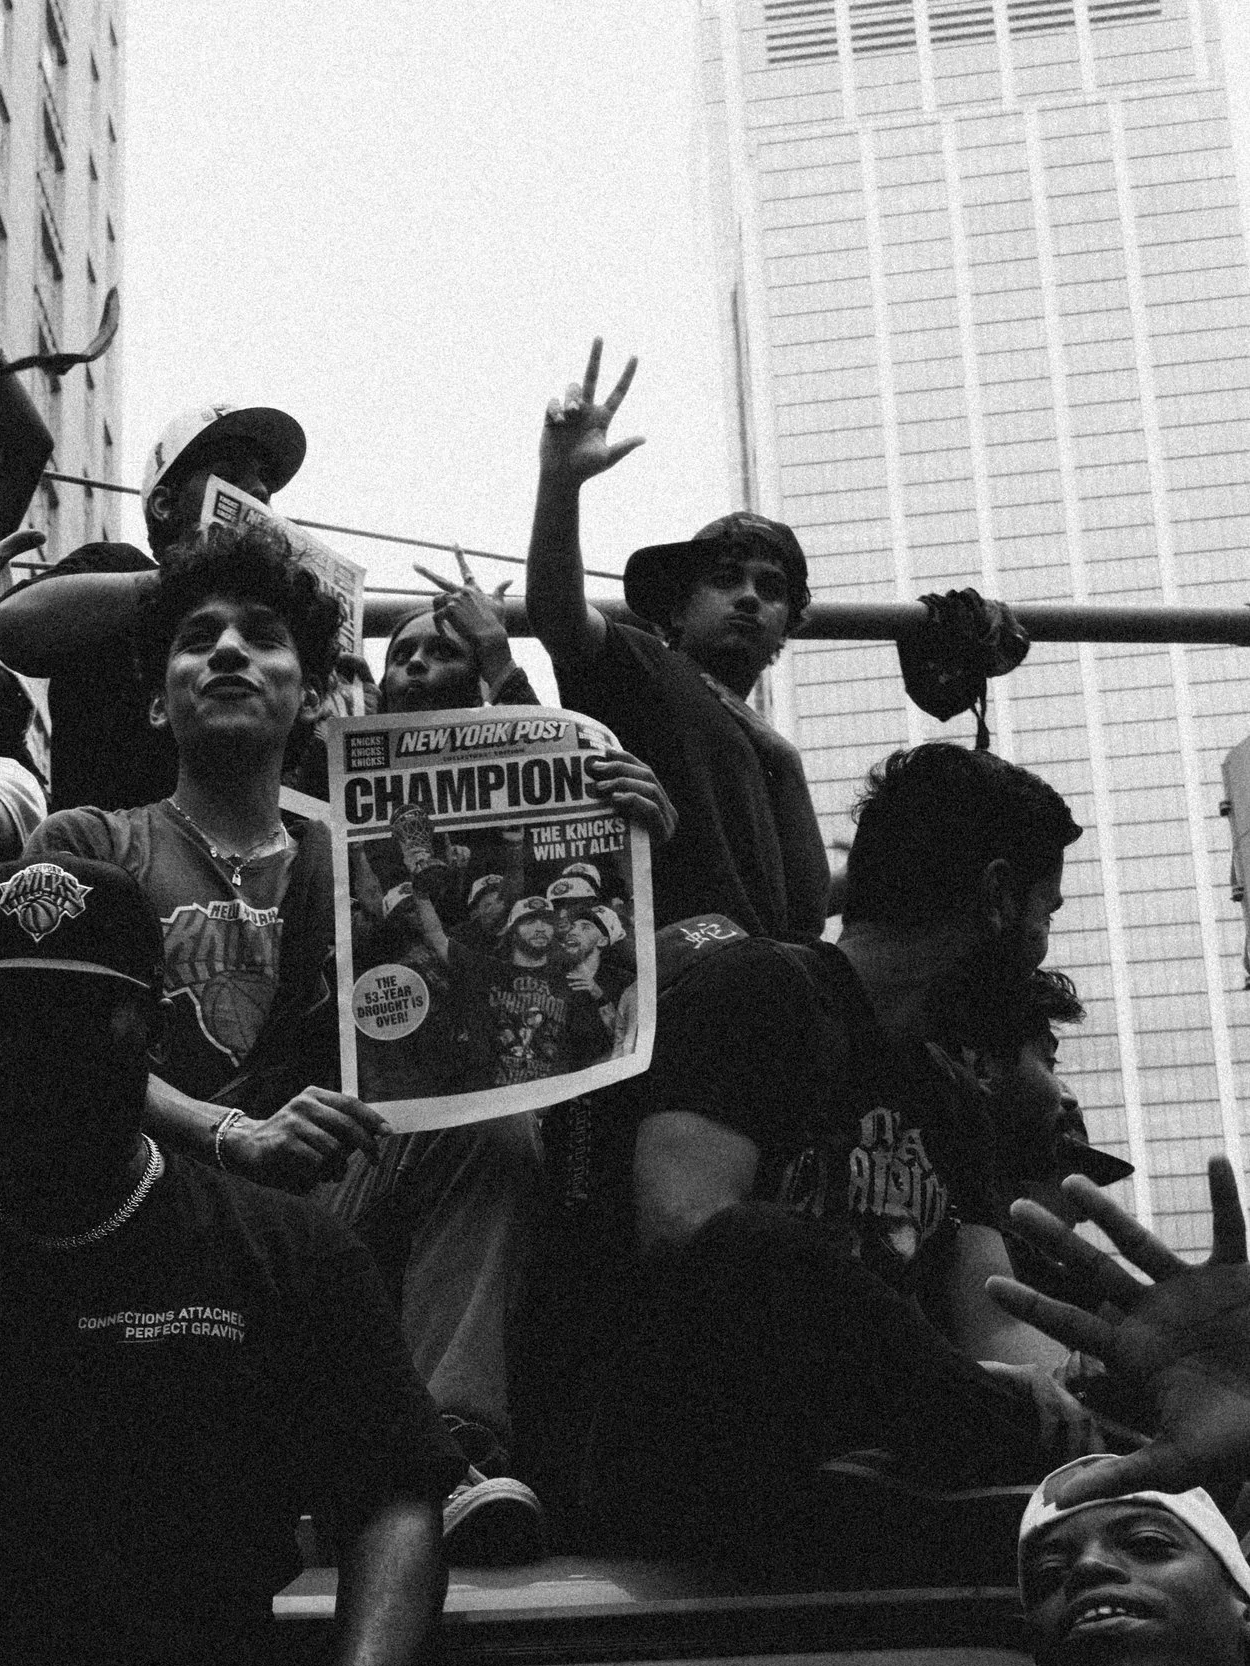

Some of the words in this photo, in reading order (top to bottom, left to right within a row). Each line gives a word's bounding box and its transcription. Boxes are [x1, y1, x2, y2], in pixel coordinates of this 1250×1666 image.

[399, 728, 451, 754] NEW
[453, 721, 511, 748] YORK
[514, 720, 570, 743] POST
[350, 756, 386, 768] KNICKS!
[530, 826, 560, 845] THE
[565, 817, 627, 841] KNICKS
[533, 843, 567, 862] WIN
[569, 841, 586, 857] IT
[589, 834, 625, 855] ALL!
[209, 902, 241, 919] NEW
[375, 975, 397, 989] THE
[364, 986, 412, 1003] 53-YEAR
[357, 1000, 410, 1019] DROUGHT
[411, 997, 423, 1009] IS
[375, 1011, 409, 1027] OVER!
[77, 1311, 175, 1330] CONNECTIONS
[125, 1322, 188, 1339] PERFECT
[191, 1322, 246, 1344] GRAVITY
